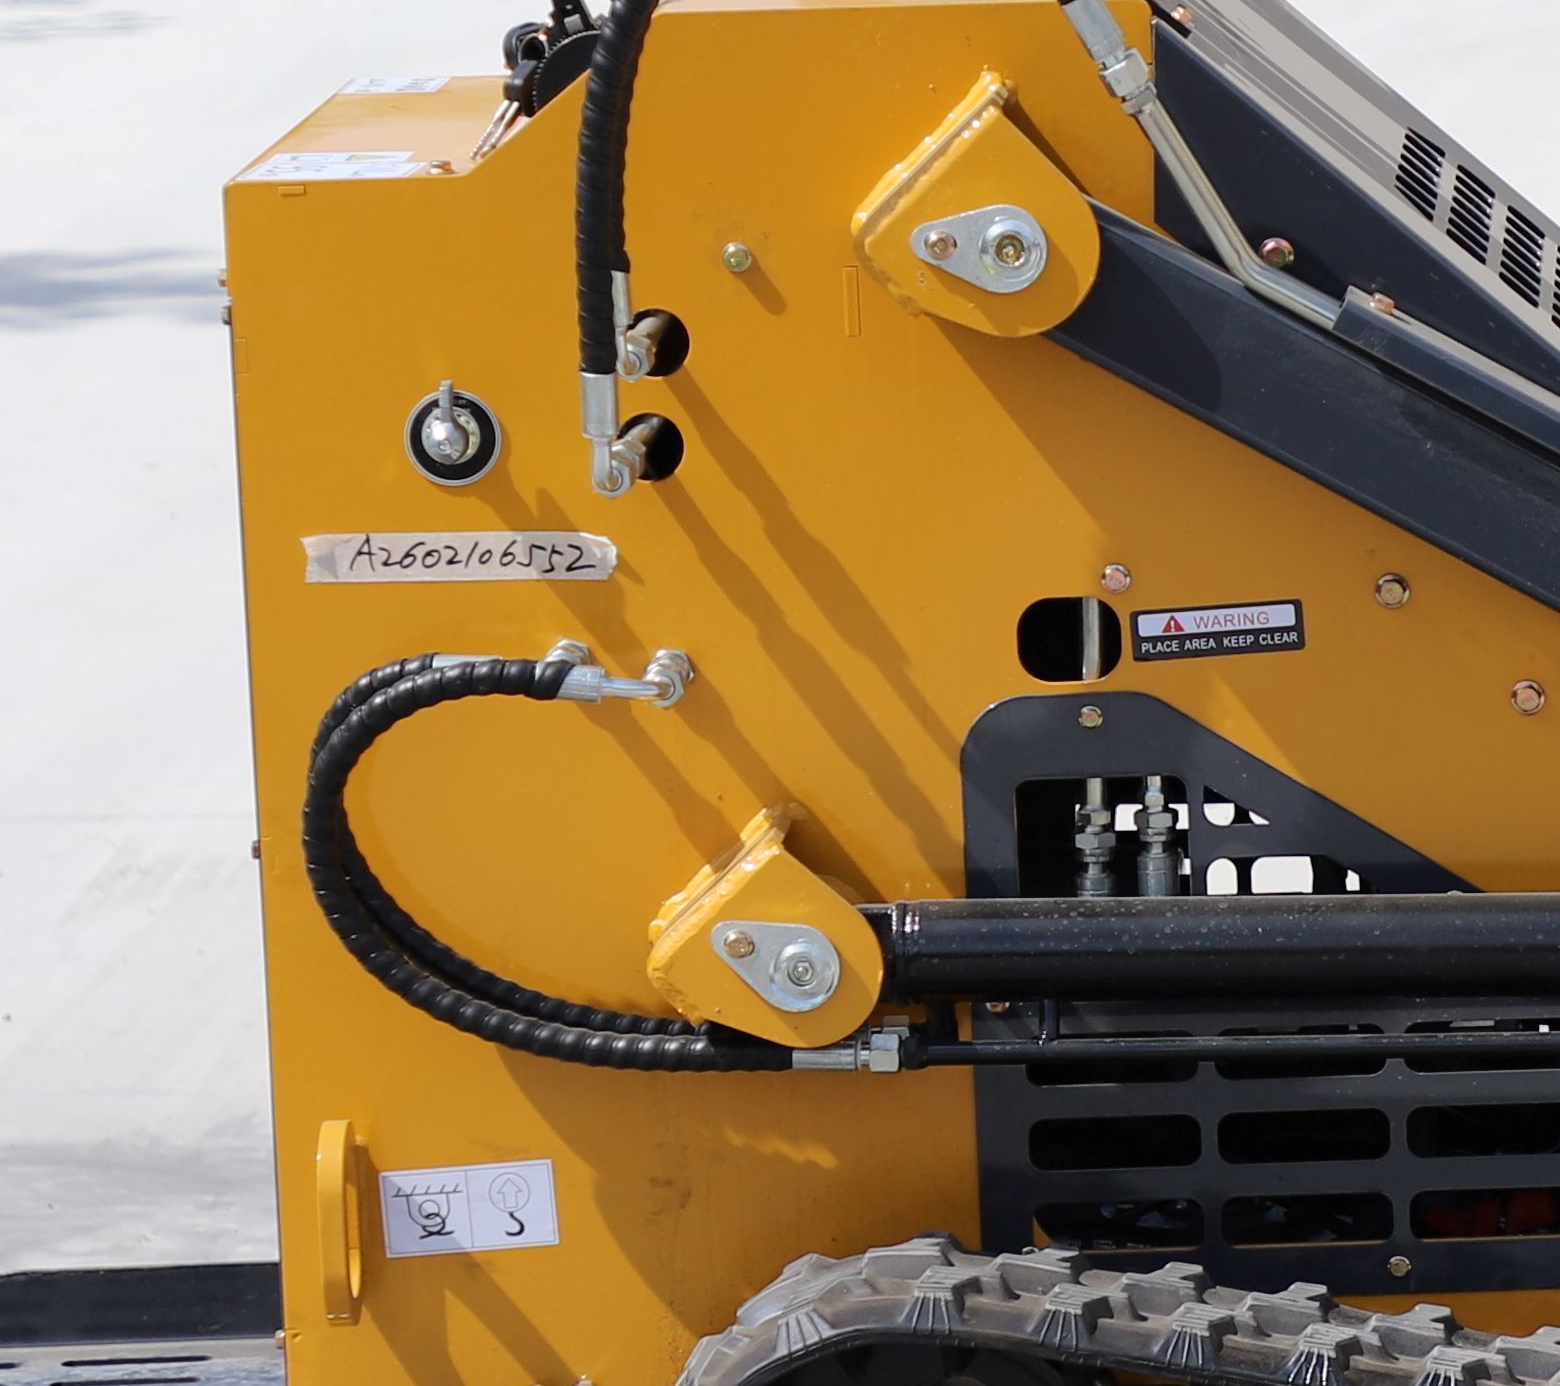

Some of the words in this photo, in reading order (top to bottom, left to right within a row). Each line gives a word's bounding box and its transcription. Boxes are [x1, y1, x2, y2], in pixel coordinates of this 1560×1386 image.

[350, 533, 597, 574] A2602106552
[1193, 611, 1270, 630] WARING
[1141, 640, 1180, 654] PLACE
[1184, 637, 1216, 651] AREA
[1223, 634, 1255, 648] KEEP
[1259, 631, 1298, 645] CLEAR
